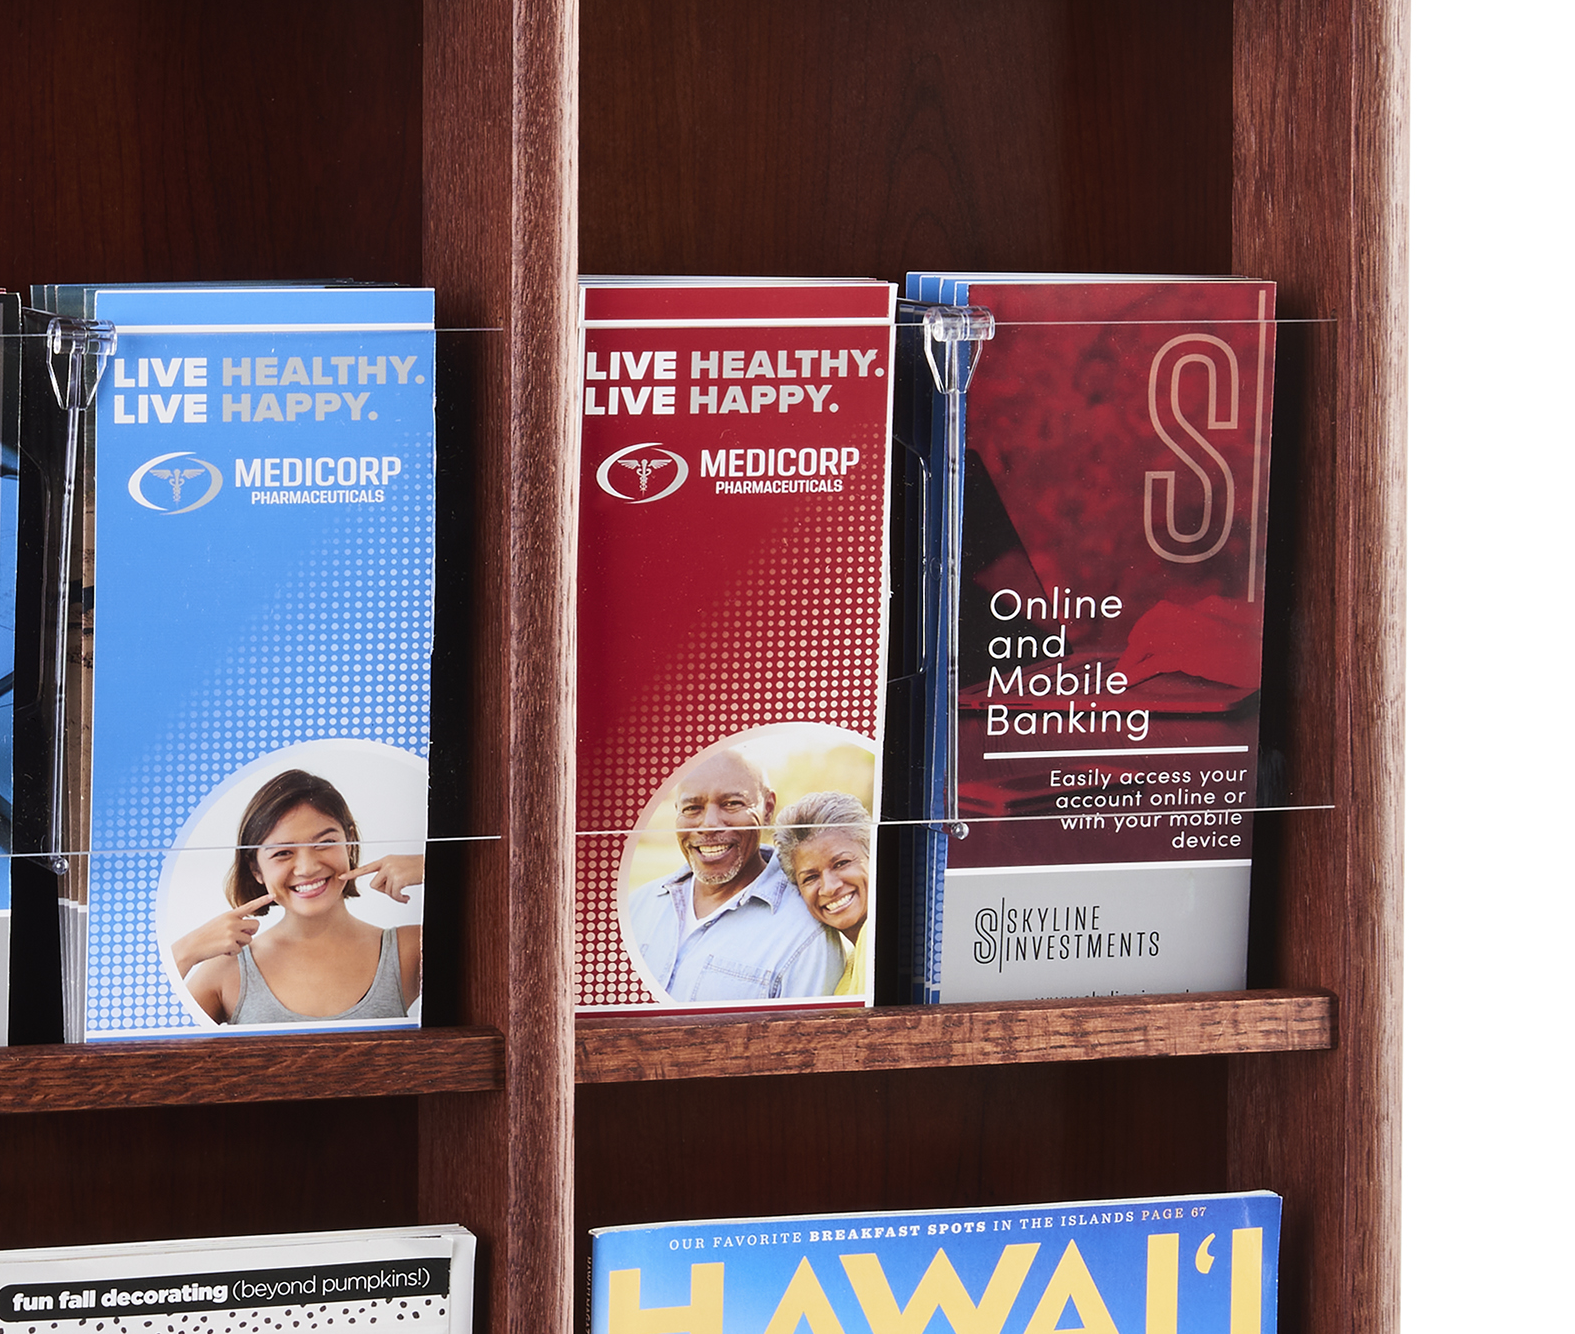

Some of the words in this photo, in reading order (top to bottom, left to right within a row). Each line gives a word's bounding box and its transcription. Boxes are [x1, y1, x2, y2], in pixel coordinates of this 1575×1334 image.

[586, 351, 676, 380] LIVE
[691, 349, 884, 378] HEALTHY.
[235, 456, 402, 487] MEDICORP
[252, 489, 384, 505] PHARMACEUTICALS
[990, 587, 1123, 621] Online
[988, 625, 1066, 659] and
[987, 663, 1128, 698] Mobile
[986, 702, 1150, 741] Banking
[1050, 770, 1110, 789] Easily
[1120, 769, 1191, 786] access
[1200, 768, 1247, 787] your
[1172, 832, 1242, 849] device
[669, 1237, 707, 1251] OUR
[713, 1232, 803, 1249] FAVORITE
[809, 1224, 920, 1242] BREAKFAST
[928, 1221, 987, 1236] SPOTS
[993, 1220, 1013, 1232] IN
[1020, 1216, 1055, 1230] THE
[1060, 1212, 1135, 1228] ISLANDS
[1141, 1207, 1185, 1221] PAGE
[1191, 1207, 1207, 1218] 67
[12, 1291, 53, 1312] fun
[59, 1286, 96, 1310] fall
[100, 1280, 228, 1310] decorating
[233, 1274, 316, 1302] (beyond
[321, 1268, 431, 1298] pumpkins!)
